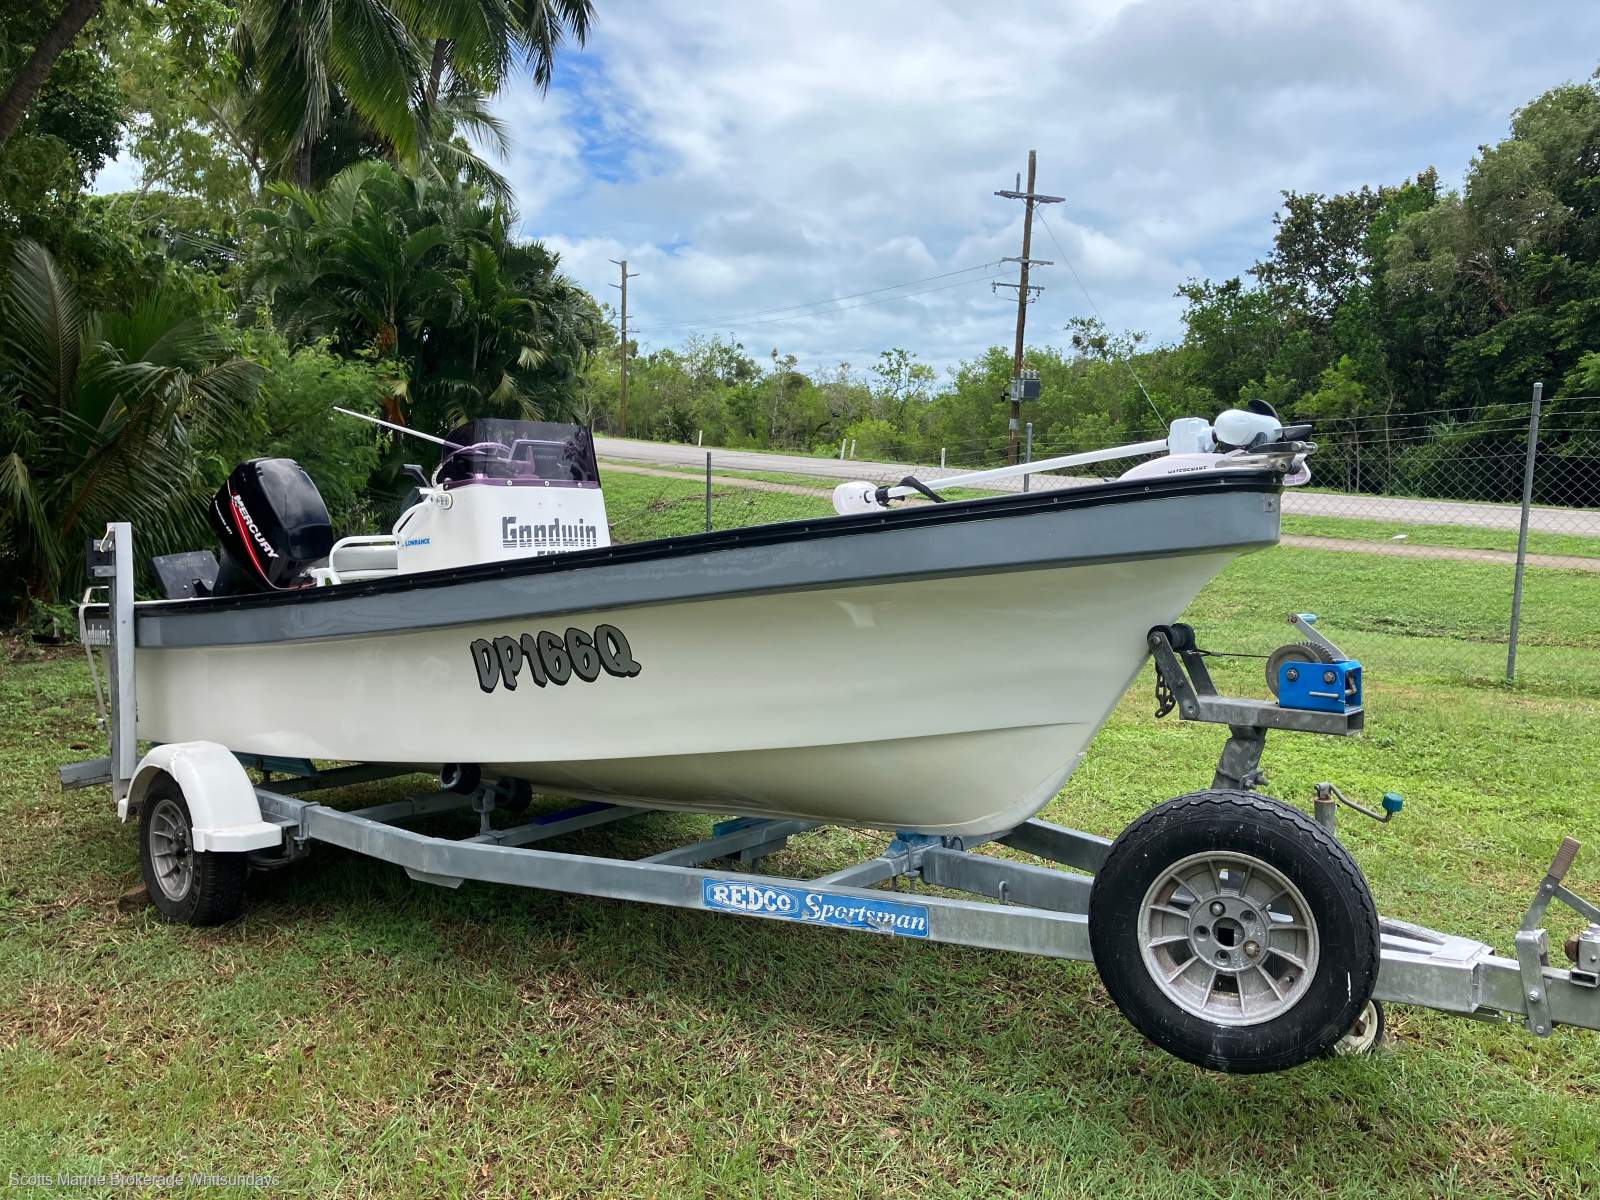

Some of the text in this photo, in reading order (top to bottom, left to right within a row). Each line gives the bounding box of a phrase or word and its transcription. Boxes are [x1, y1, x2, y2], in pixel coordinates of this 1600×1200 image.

[233, 494, 279, 558] MERCURY
[502, 516, 598, 548] Goodwin
[470, 624, 642, 694] DP166Q
[713, 884, 926, 931] REDCO Sportsman
